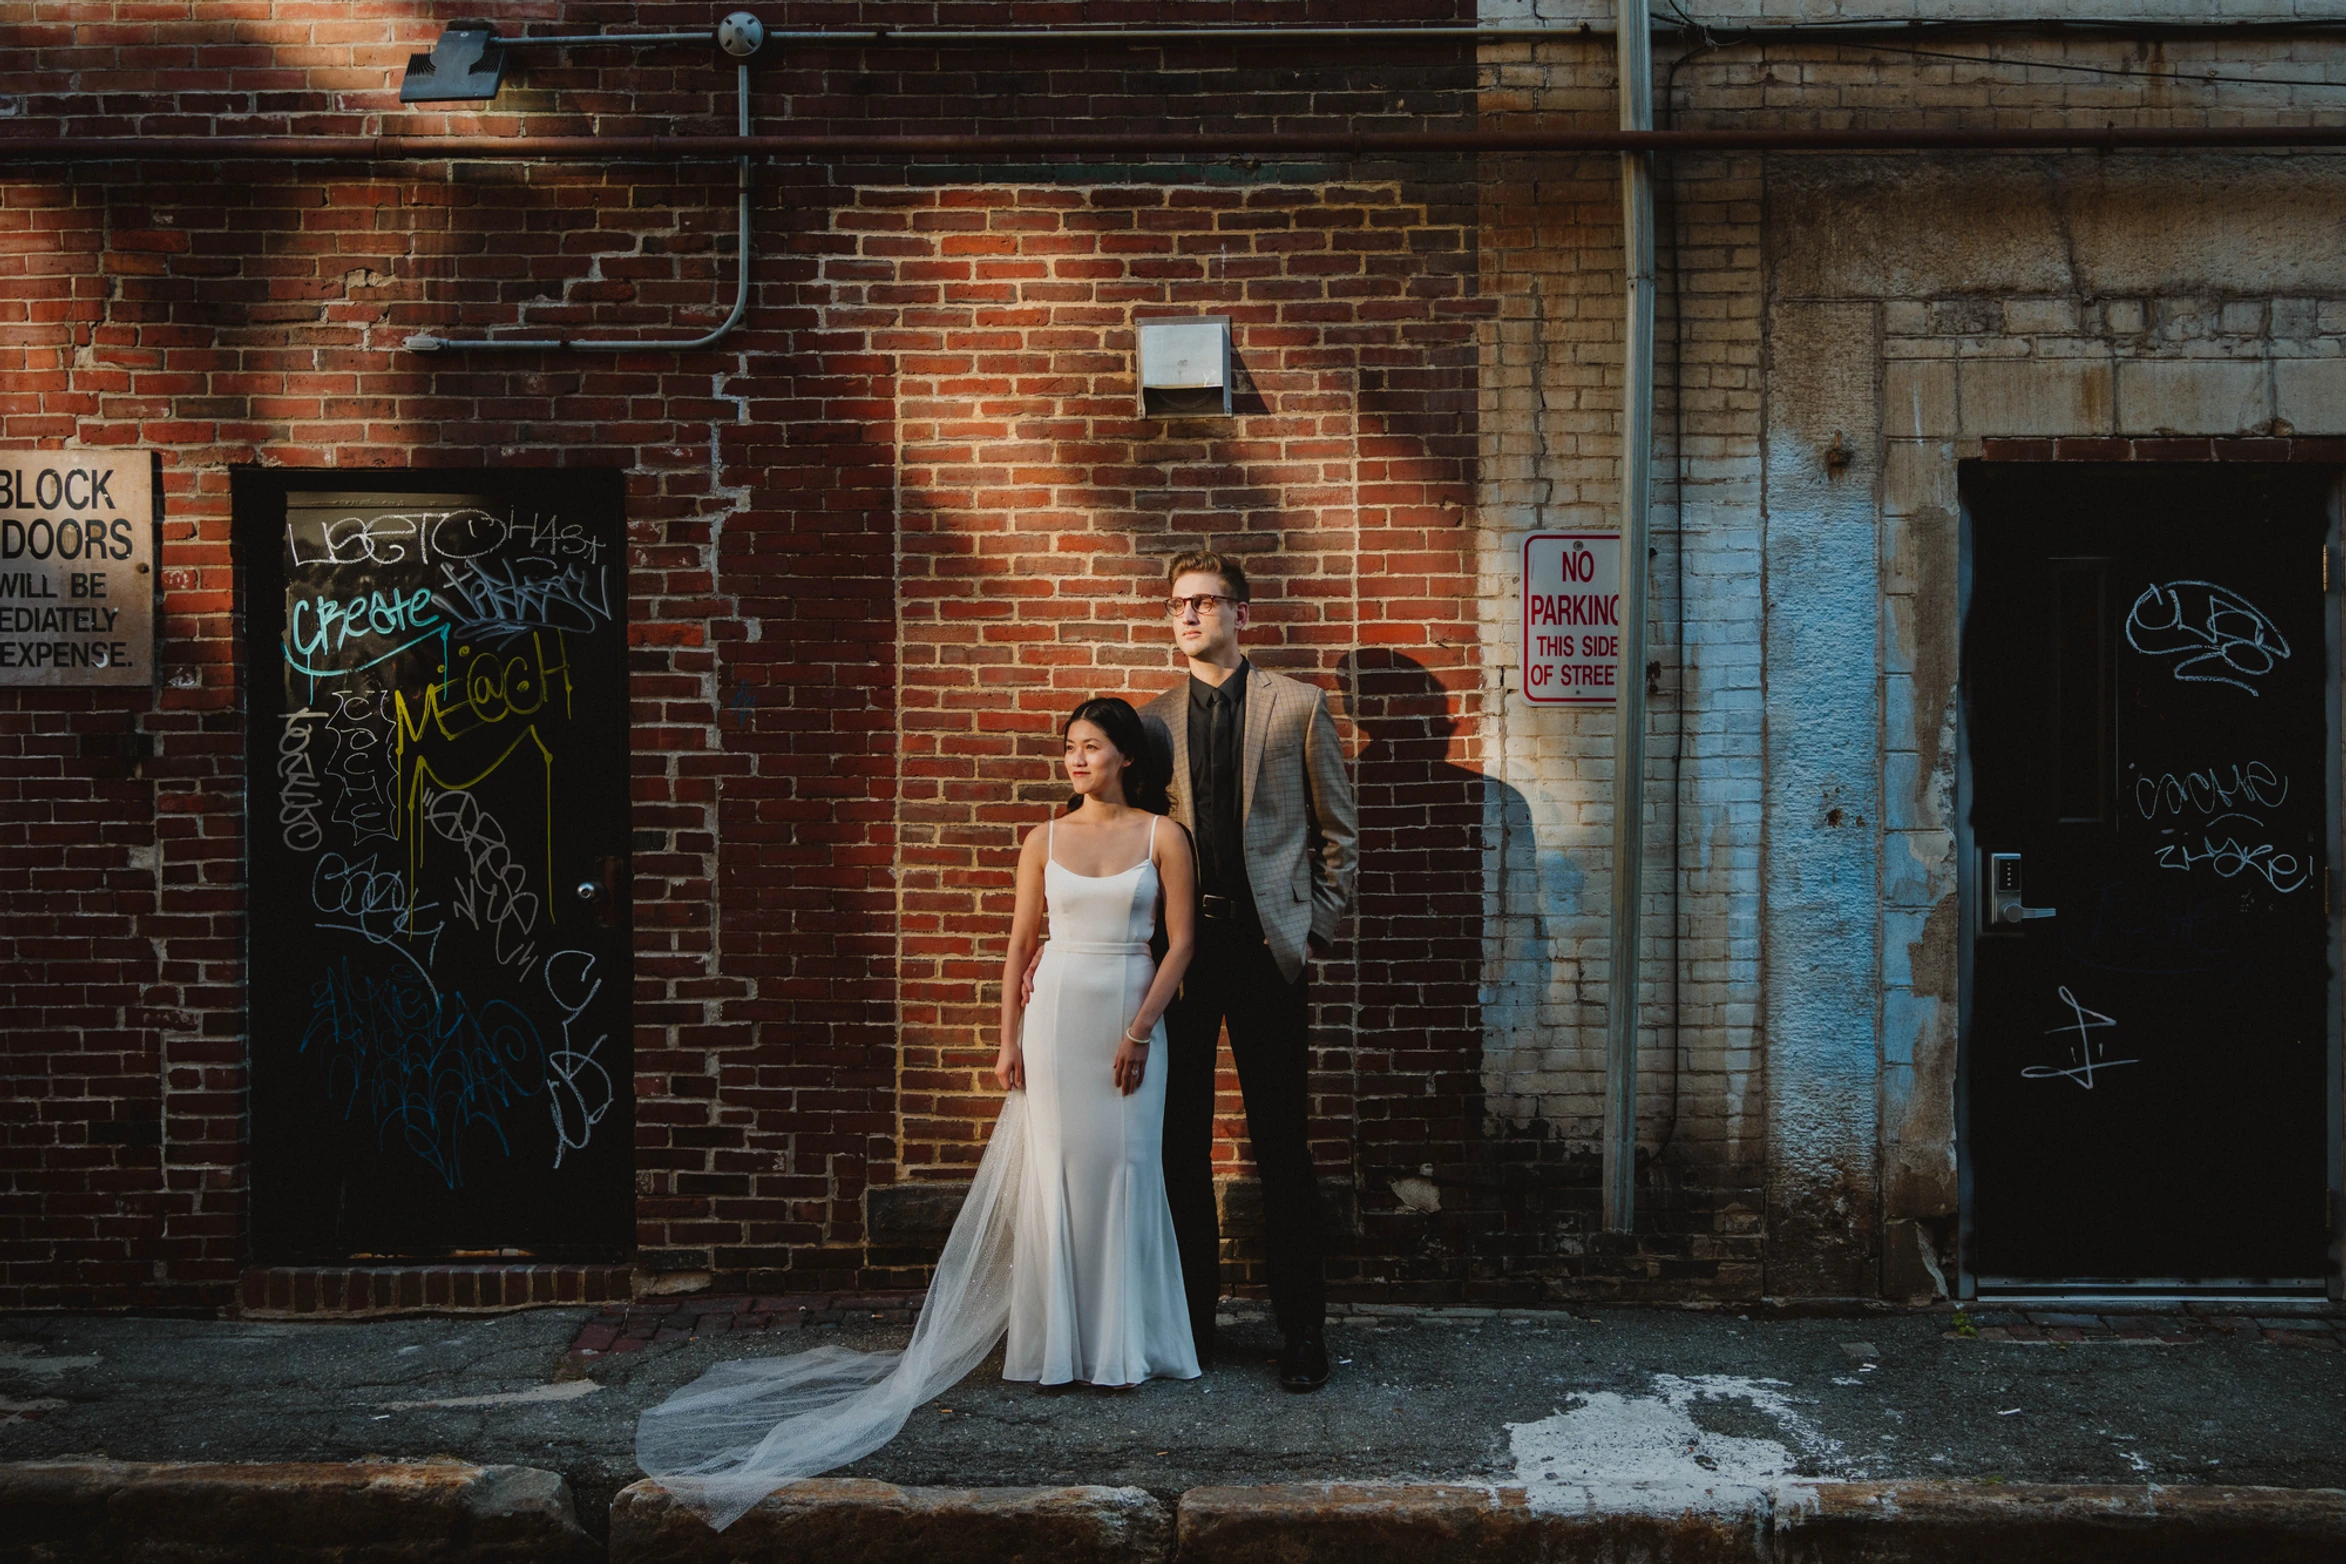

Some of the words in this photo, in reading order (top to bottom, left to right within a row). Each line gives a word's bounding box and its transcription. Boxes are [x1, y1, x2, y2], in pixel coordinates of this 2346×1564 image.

[0, 469, 116, 510] BLOCK
[2, 518, 133, 560] DOORS
[1562, 550, 1595, 583] NO
[0, 573, 58, 598] WILL
[71, 573, 107, 598] BE
[0, 607, 119, 633] EDIATELY
[0, 642, 133, 668] EXPENSE.
[1536, 635, 1575, 657] THIS
[1582, 635, 1618, 657] SIDE
[1530, 664, 1554, 686] OF
[1560, 664, 1618, 686] STREE
